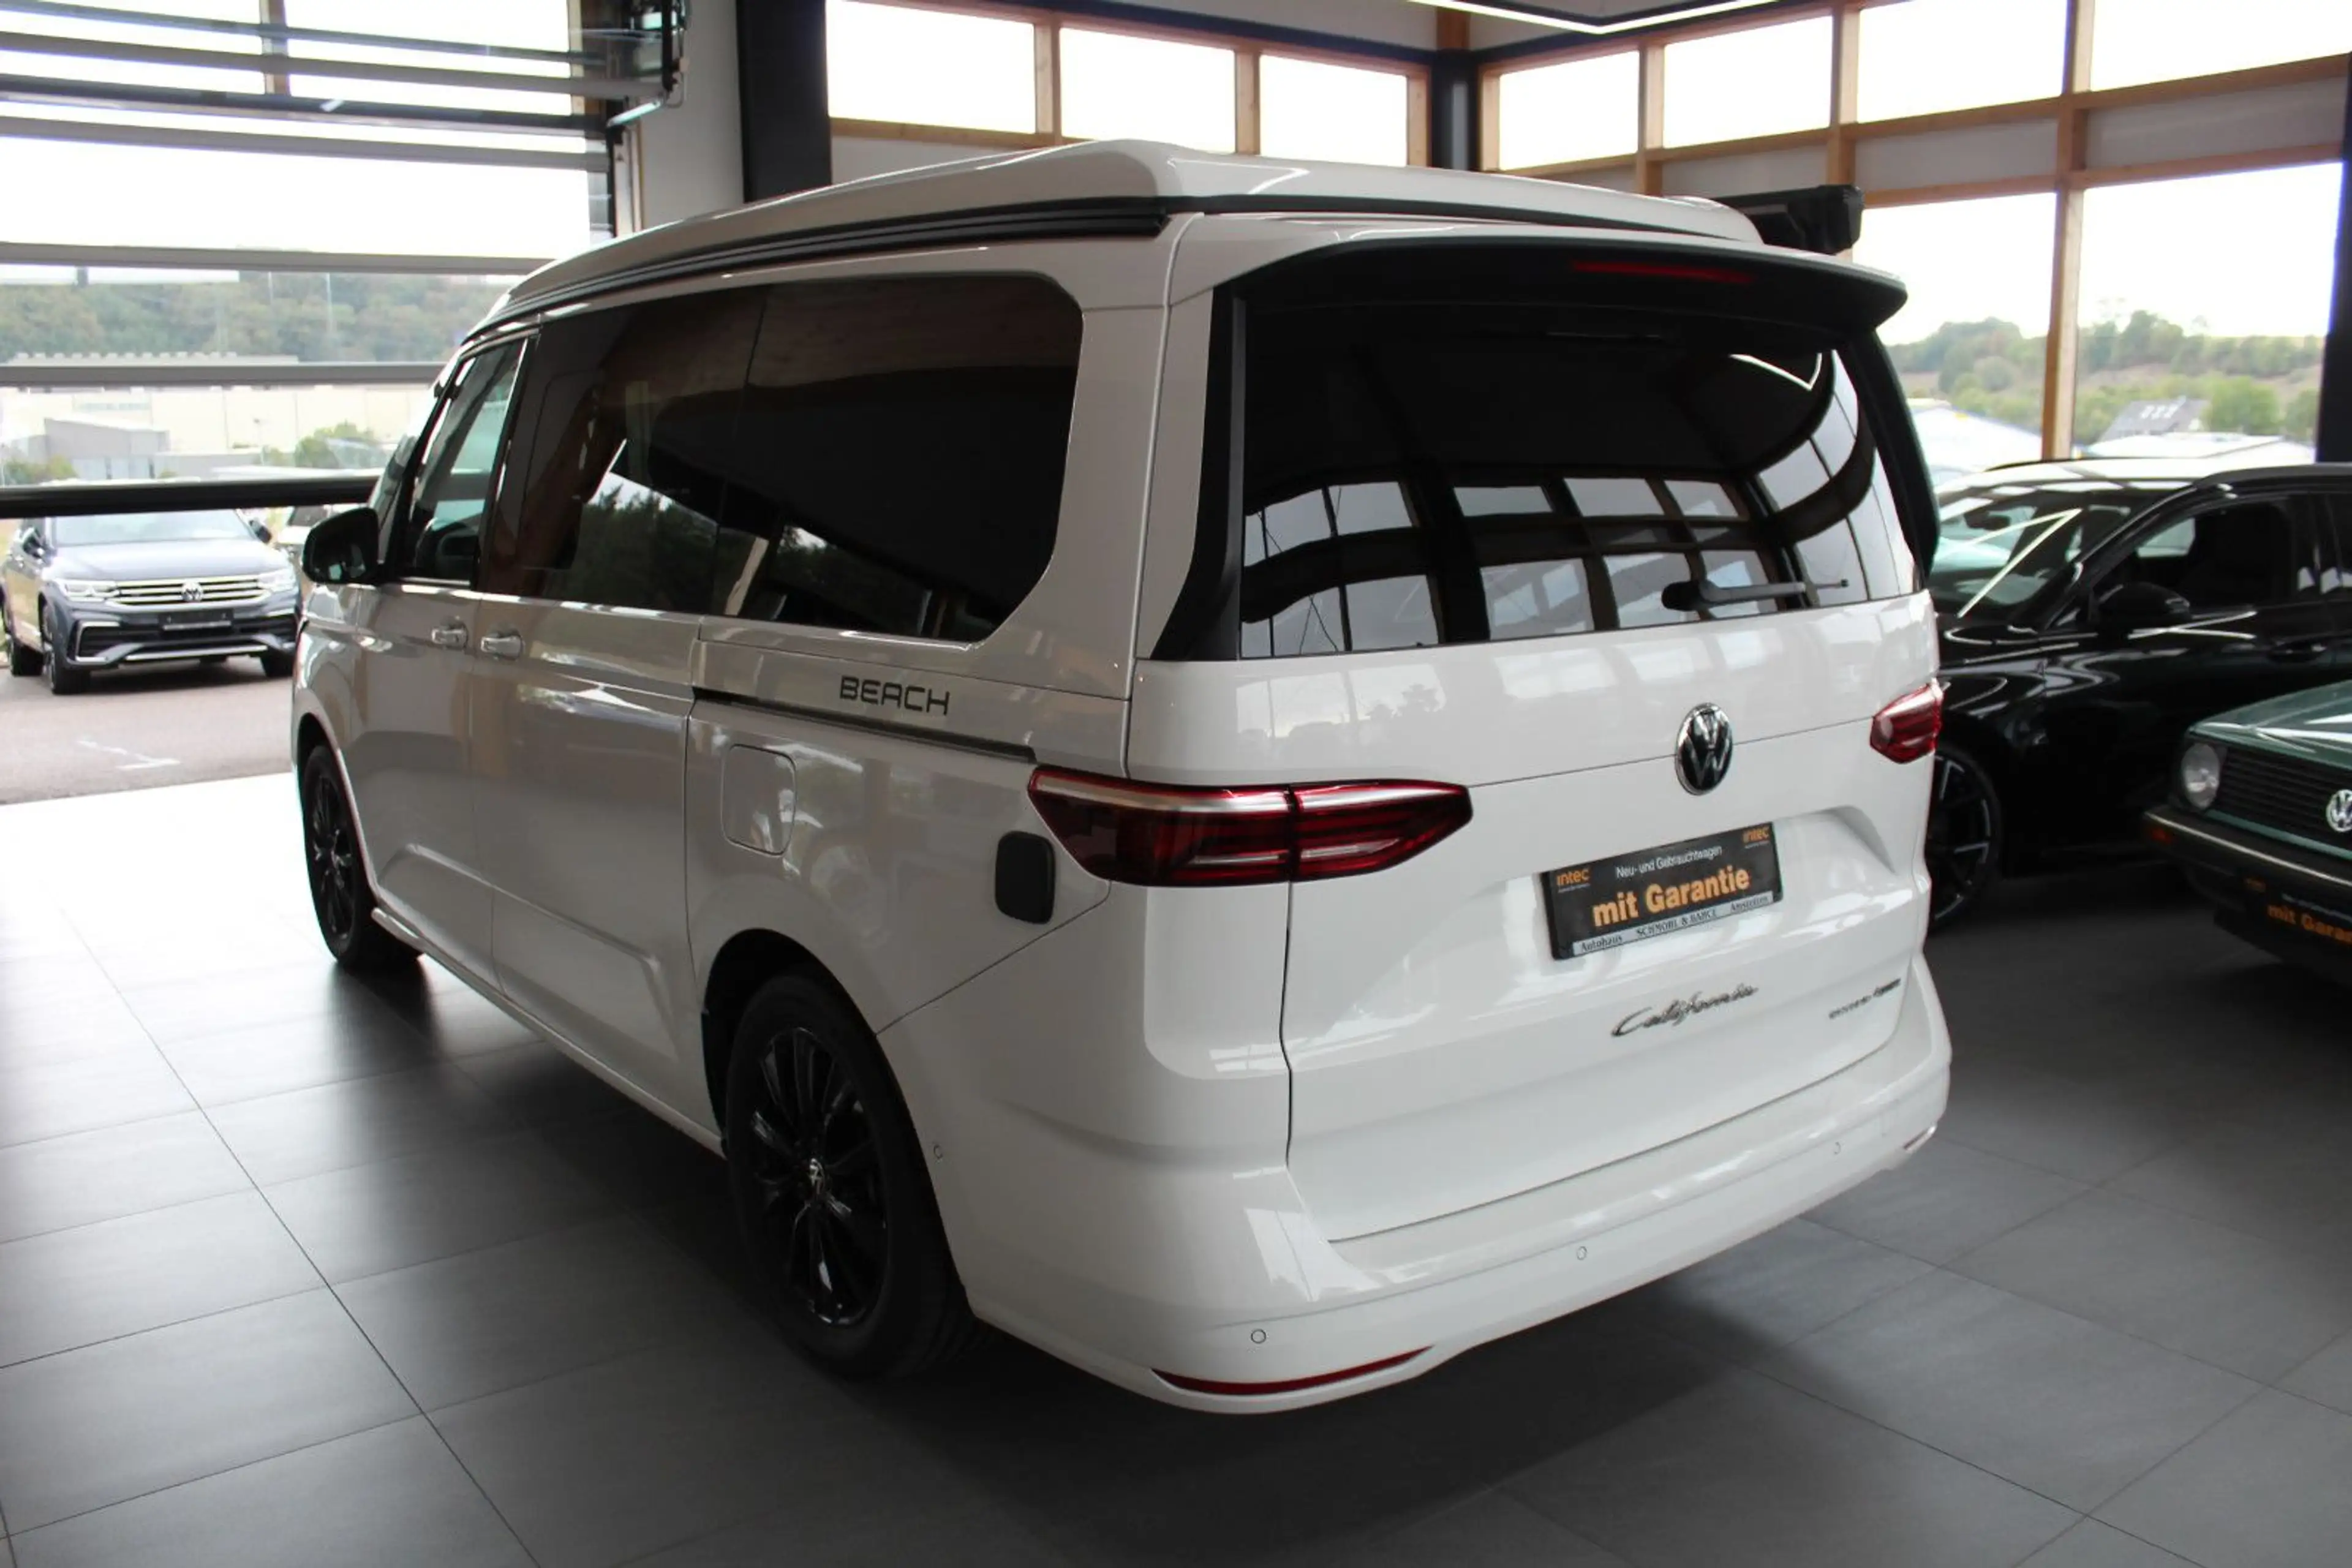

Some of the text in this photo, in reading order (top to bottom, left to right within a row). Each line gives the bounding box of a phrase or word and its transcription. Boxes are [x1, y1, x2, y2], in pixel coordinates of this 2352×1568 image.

[840, 676, 950, 715] BEACH
[1616, 865, 1638, 878] Neu-
[1639, 859, 1655, 873] und
[1593, 864, 1751, 927] mit Garantie
